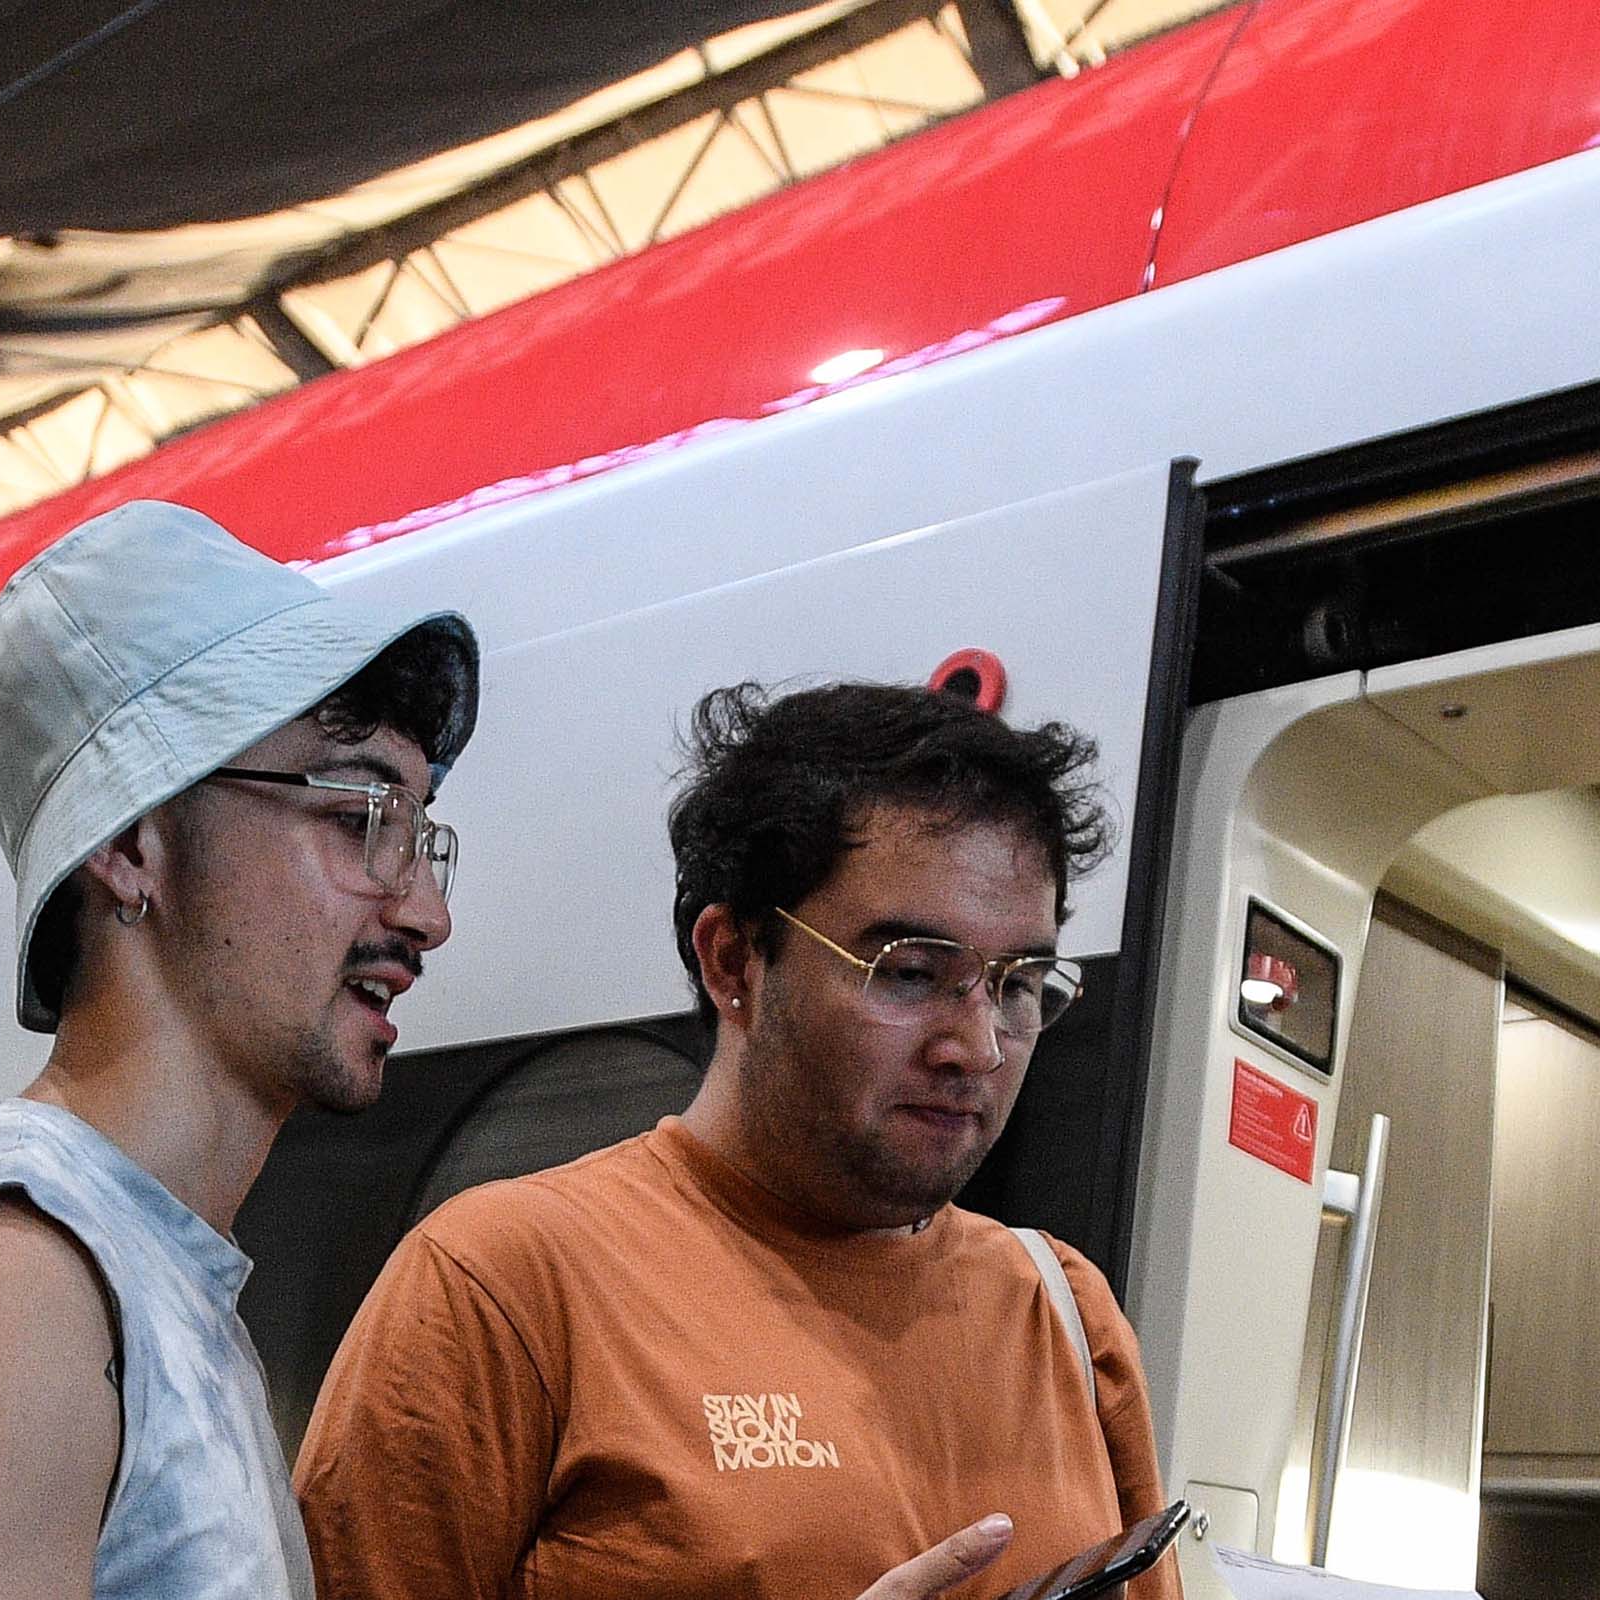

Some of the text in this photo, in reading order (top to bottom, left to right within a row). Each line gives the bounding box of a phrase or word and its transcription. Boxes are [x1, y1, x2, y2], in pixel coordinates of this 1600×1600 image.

[702, 1393, 803, 1421] STAY IN
[709, 1417, 797, 1445] SLOW
[713, 1439, 840, 1472] MOTION
